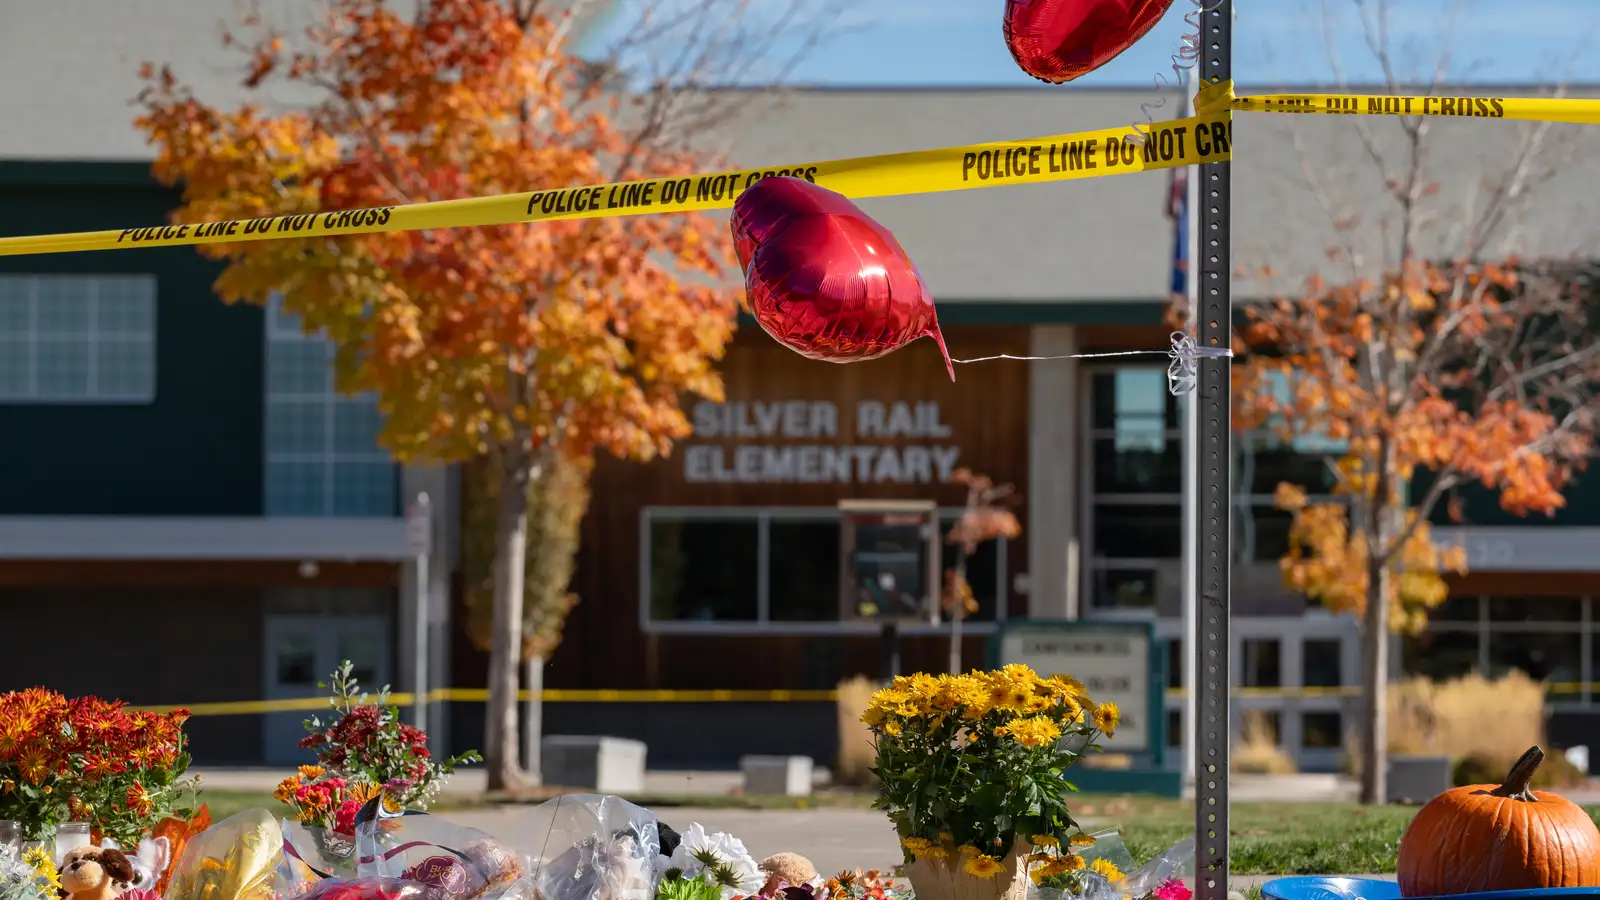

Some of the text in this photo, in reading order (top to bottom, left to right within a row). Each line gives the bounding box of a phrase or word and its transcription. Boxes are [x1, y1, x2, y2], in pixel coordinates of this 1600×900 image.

[1368, 97, 1415, 115] NOT
[1423, 97, 1504, 118] CROSS
[963, 119, 1232, 181] POLICE LINE DO NOT CR
[527, 186, 604, 215] POLICE
[607, 181, 657, 209] LINE
[660, 178, 692, 204] DO
[696, 173, 741, 202] NOT
[117, 206, 396, 243] POLICE LINE DO NOT CROSS
[693, 401, 952, 437] SILVER RAIL
[684, 445, 960, 483] ELEMENTARY
